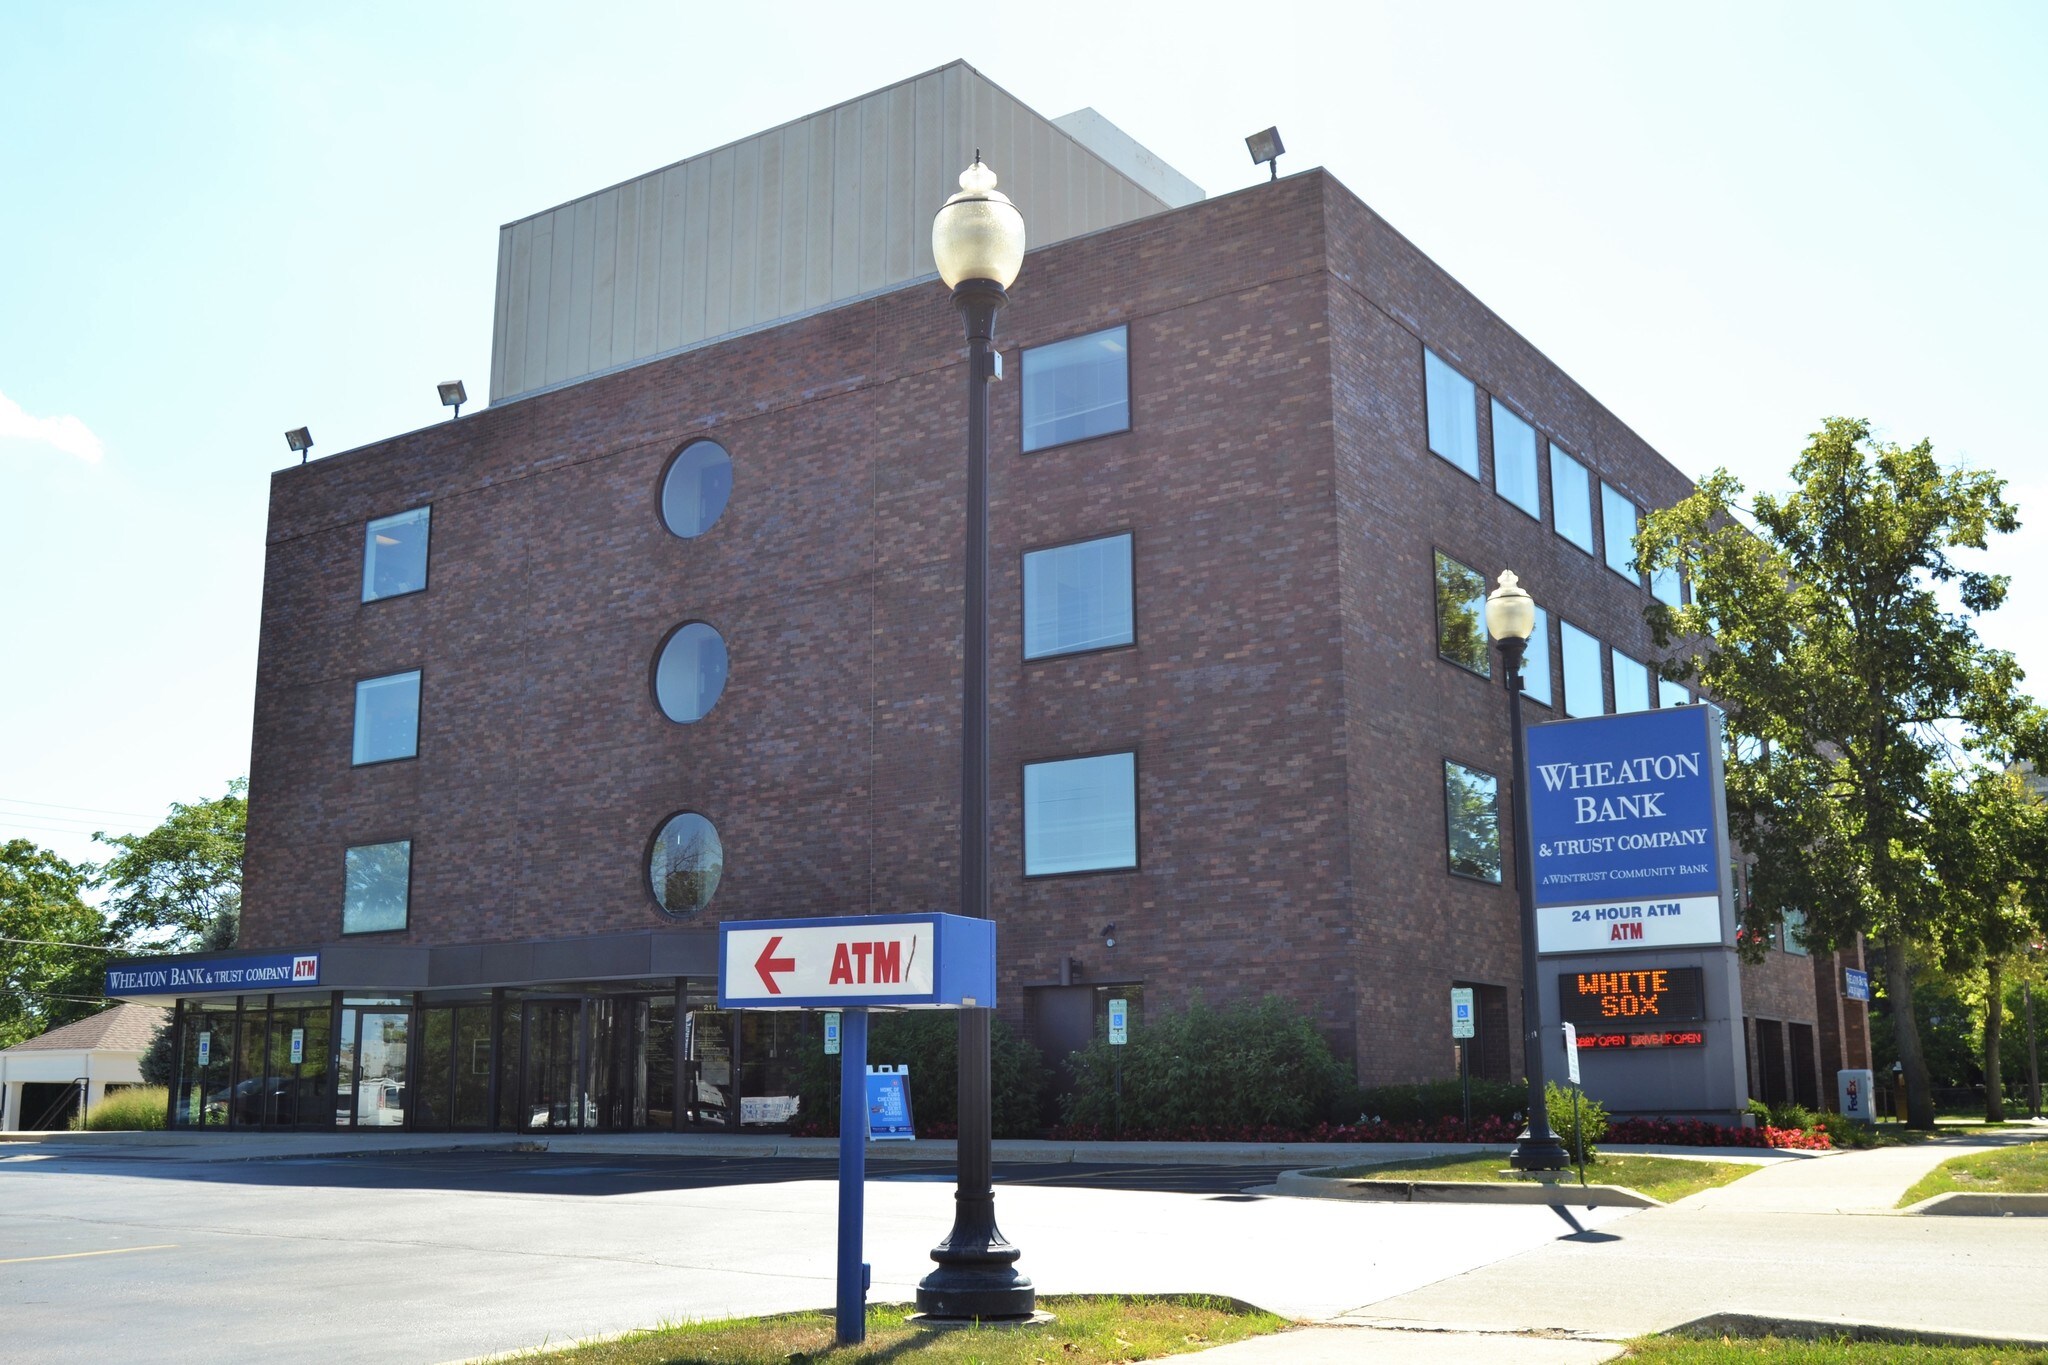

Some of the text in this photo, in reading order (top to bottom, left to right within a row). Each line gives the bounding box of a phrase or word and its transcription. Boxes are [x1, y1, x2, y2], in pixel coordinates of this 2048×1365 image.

[1536, 752, 1700, 793] WHEATON
[1574, 792, 1666, 824] BANK
[1538, 828, 1708, 857] & TRUST COMPANY
[1549, 871, 1607, 884] WINTRUST
[1609, 866, 1676, 880] COMMUNITY
[1679, 864, 1709, 874] BANK
[1571, 903, 1681, 922] 24 HOUR ATM
[1610, 922, 1643, 941] ATM
[294, 960, 316, 977] ATM
[828, 941, 901, 985] ATM
[109, 966, 291, 990] WHEATON BANK & TRUST COMPANY
[1577, 970, 1669, 995] WHITE
[1601, 994, 1660, 1017] SOX
[1575, 1037, 1596, 1047] OBBY
[1598, 1035, 1626, 1047] OPEN
[1672, 1032, 1702, 1045] OPEN
[1846, 1080, 1858, 1112] FedEx
